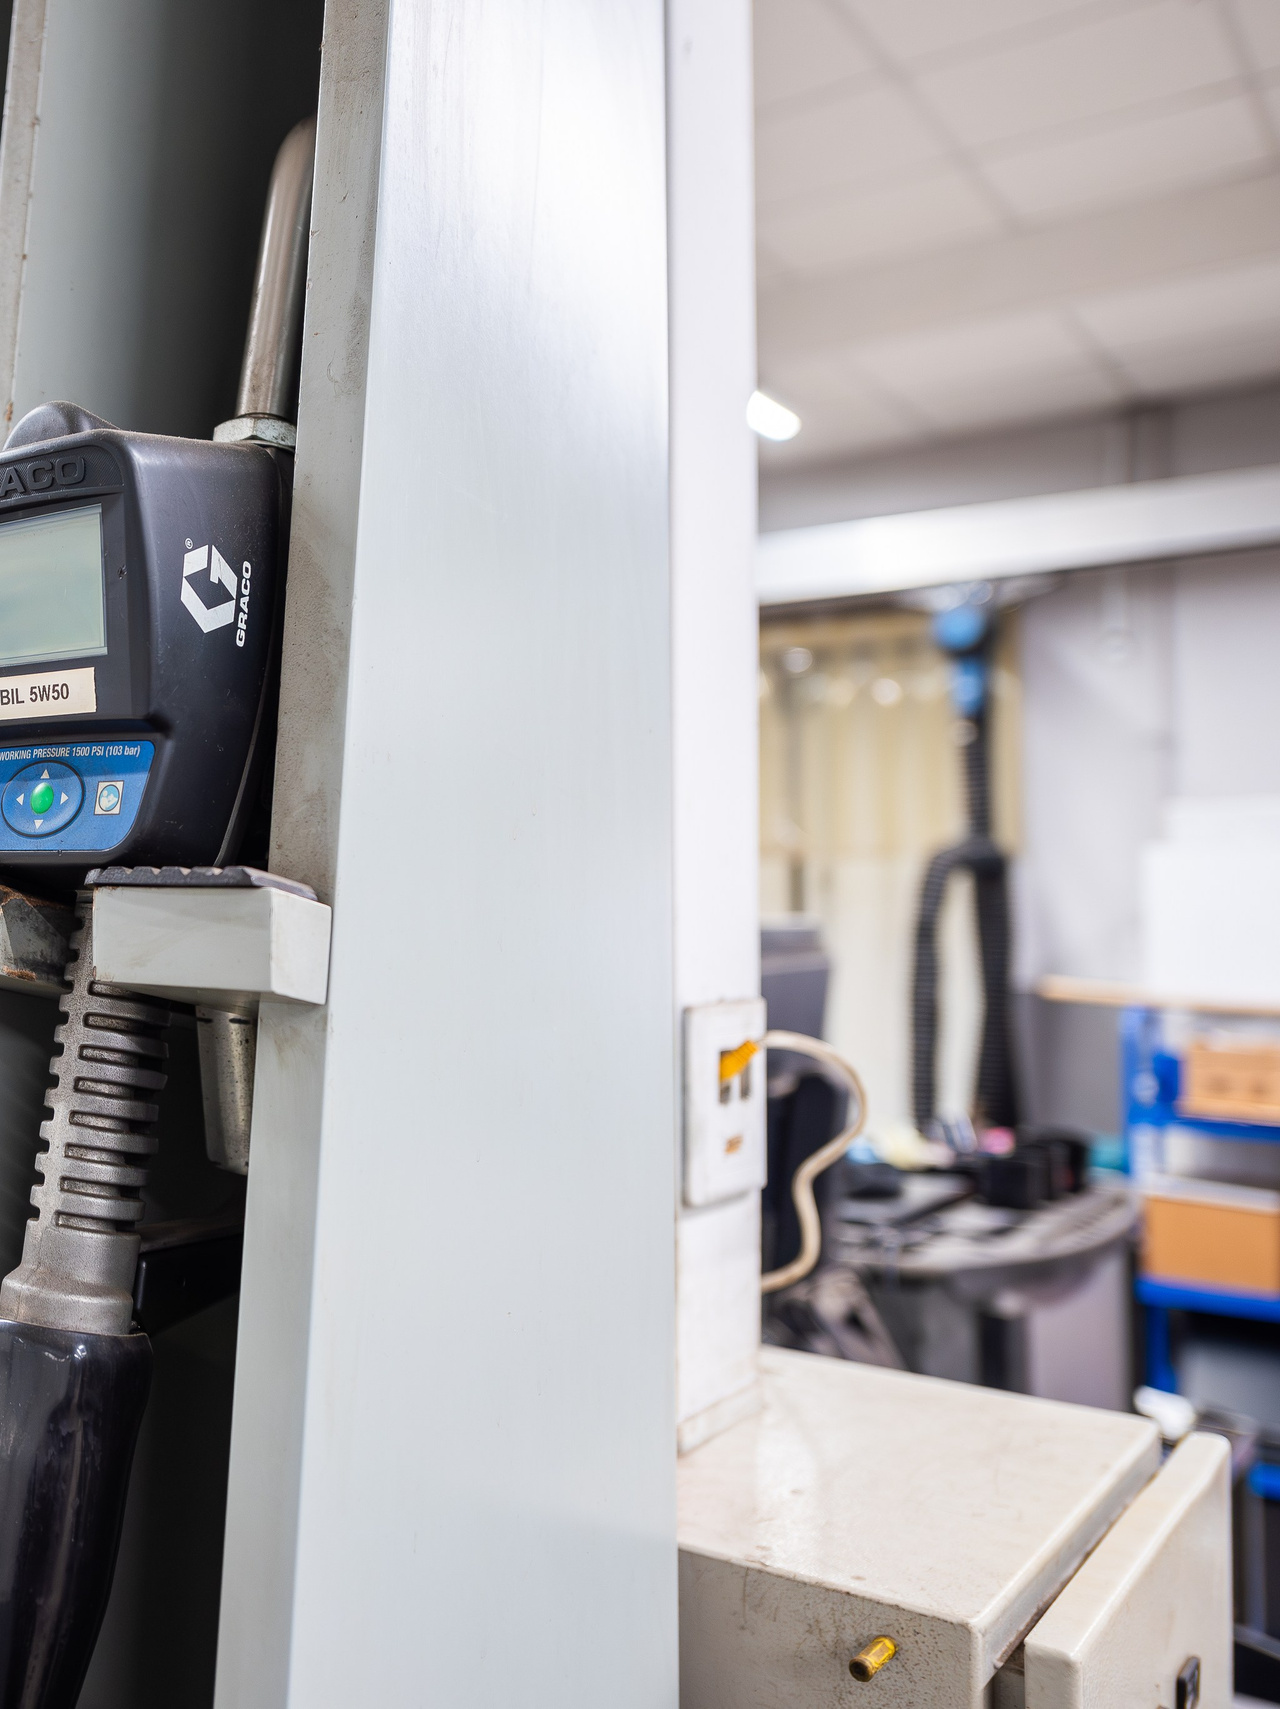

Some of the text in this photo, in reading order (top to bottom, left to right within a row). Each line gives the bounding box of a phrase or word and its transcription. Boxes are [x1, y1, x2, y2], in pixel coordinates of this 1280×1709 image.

[236, 561, 252, 647] GRACO
[29, 683, 70, 702] 5W50
[32, 747, 70, 759] PRESSURE
[72, 746, 90, 757] 1500
[91, 745, 104, 757] PSI
[105, 745, 123, 758] (103
[124, 745, 140, 758] bar)
